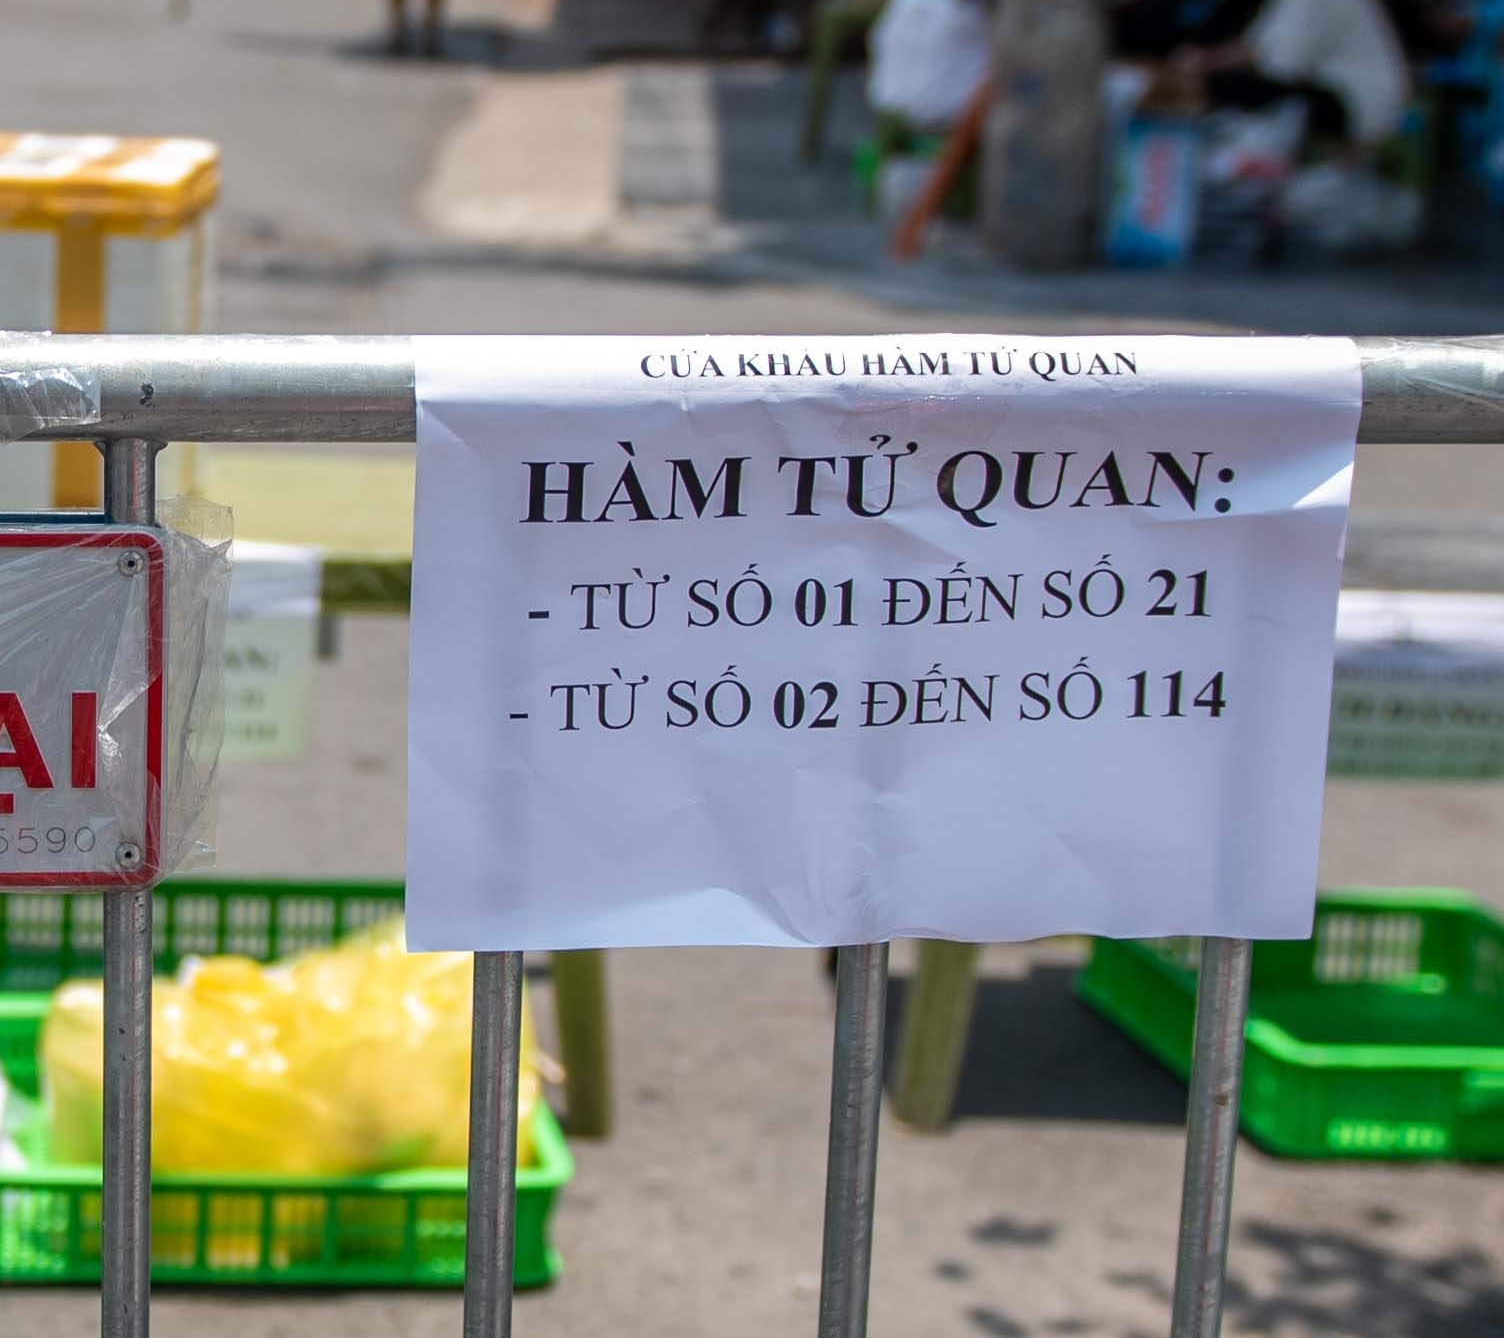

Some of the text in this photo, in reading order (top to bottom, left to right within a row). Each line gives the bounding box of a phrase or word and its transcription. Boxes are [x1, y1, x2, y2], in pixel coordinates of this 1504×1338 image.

[1028, 351, 1138, 382] QUAN
[519, 435, 1234, 528] HÀM TỬ QUAN:
[571, 568, 670, 630] TỪ
[688, 563, 772, 628] SỐ
[795, 578, 859, 627] 01
[881, 562, 1024, 626] ĐẾN
[1041, 554, 1125, 619] SỐ
[1145, 569, 1212, 617] 21
[551, 668, 649, 731] TỪ
[666, 665, 751, 728] SỐ
[774, 681, 839, 729] 02
[859, 663, 1000, 727] ĐẾN
[1019, 656, 1103, 721] SỐ
[1126, 670, 1226, 718] 114
